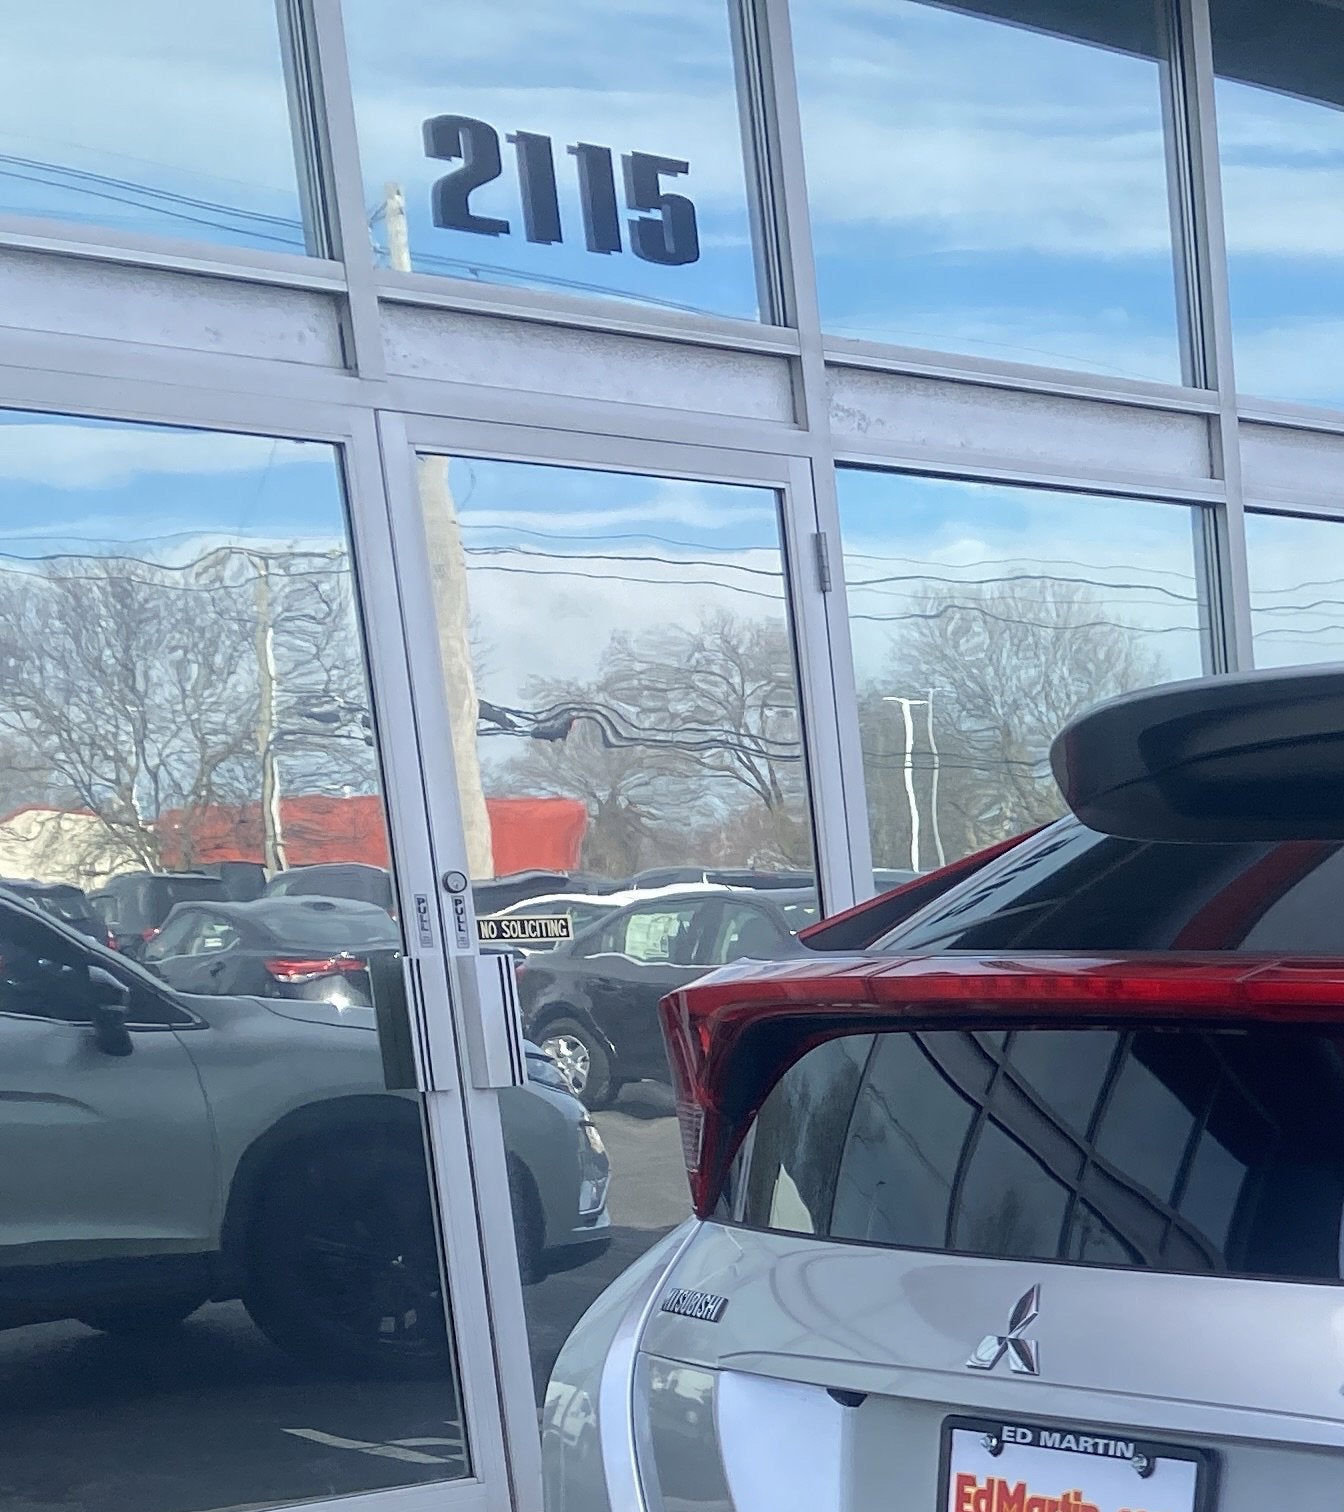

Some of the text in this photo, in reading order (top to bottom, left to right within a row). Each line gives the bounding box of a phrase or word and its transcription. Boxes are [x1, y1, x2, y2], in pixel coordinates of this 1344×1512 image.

[422, 114, 700, 266] 2115
[416, 897, 430, 932] PULL
[454, 898, 466, 933] PULL
[480, 919, 567, 939] NO SOLICITING
[1001, 1426, 1135, 1459] ED MARTIN
